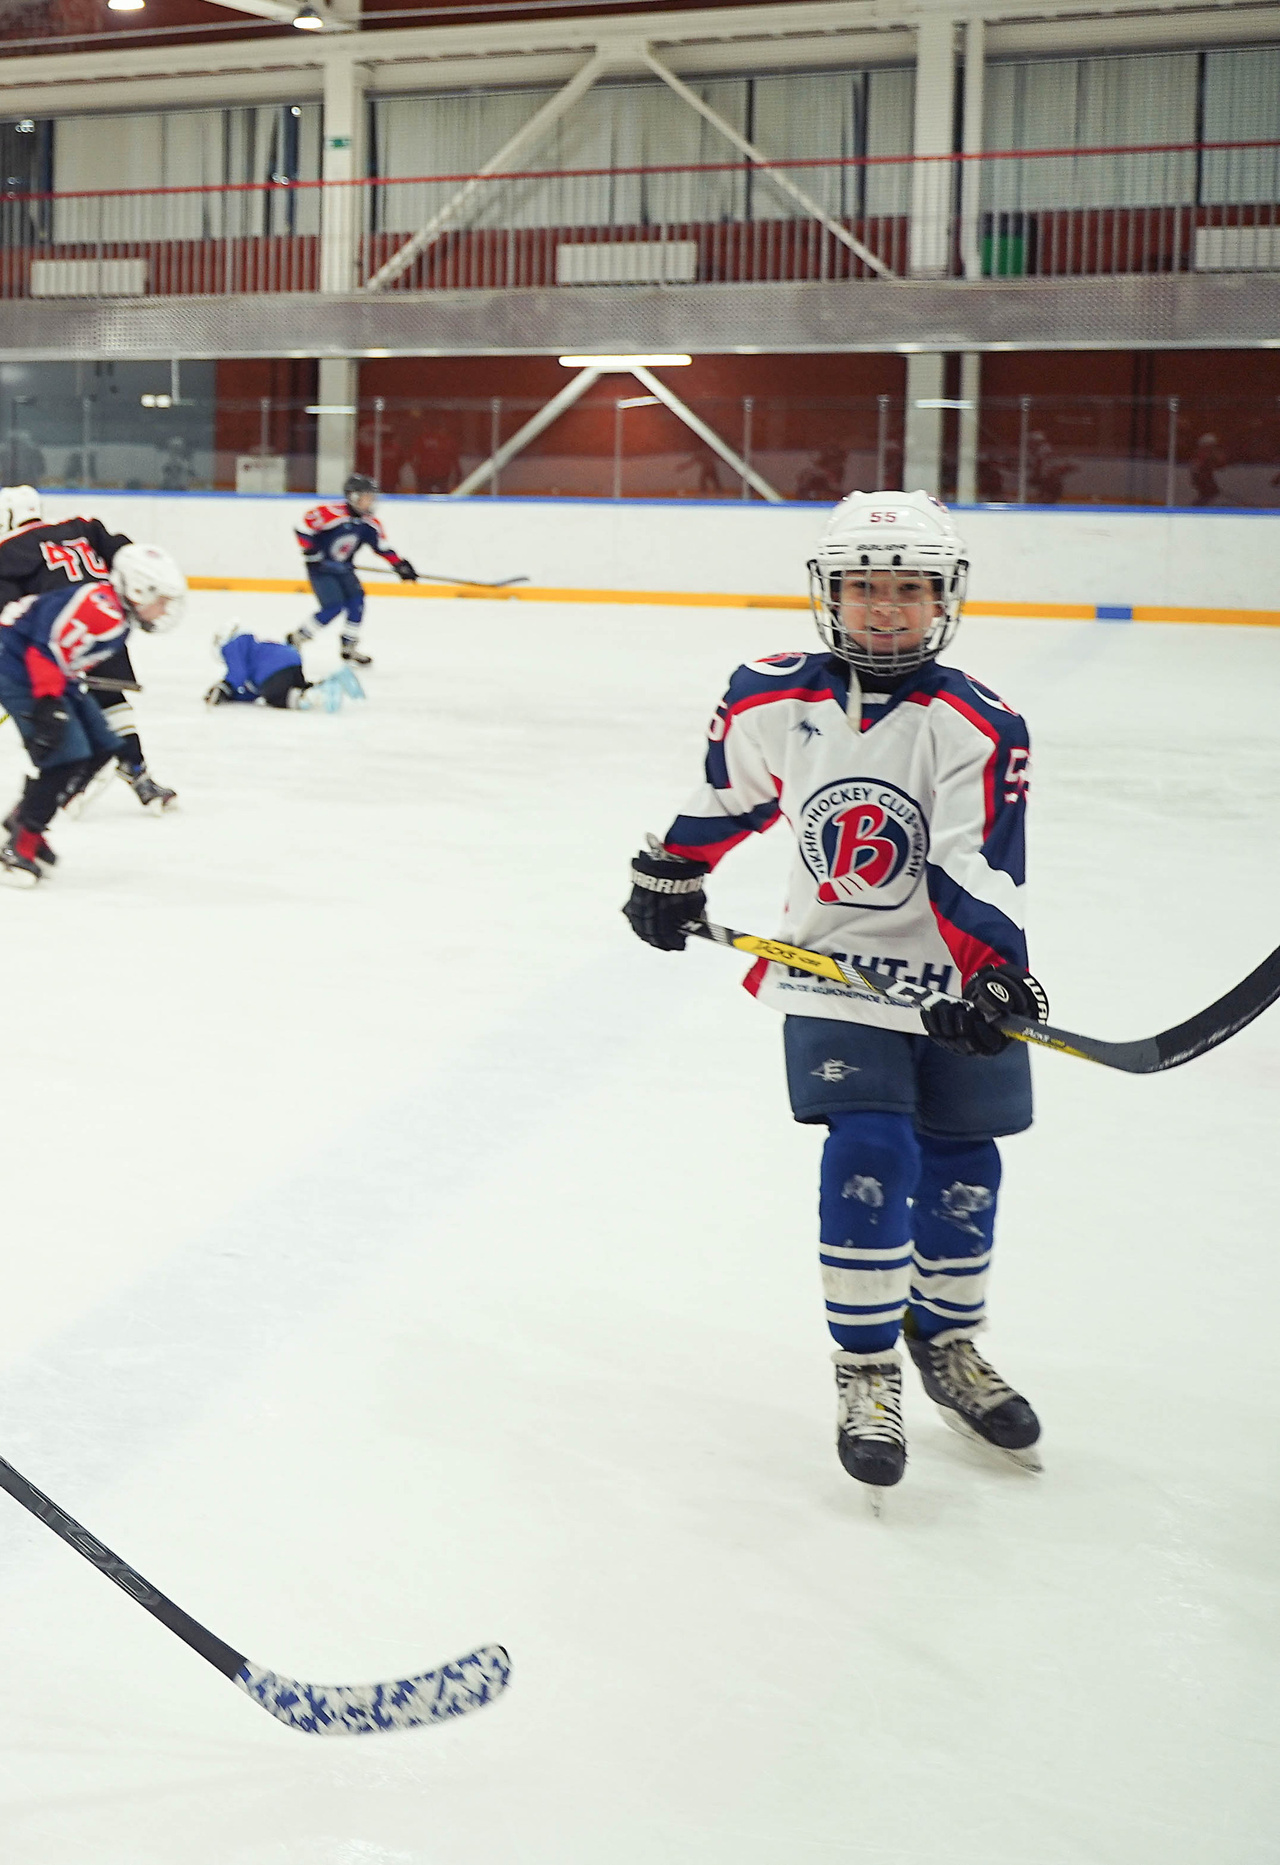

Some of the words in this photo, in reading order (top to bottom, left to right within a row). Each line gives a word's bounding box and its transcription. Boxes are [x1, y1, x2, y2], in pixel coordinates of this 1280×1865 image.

[870, 511, 897, 523] 55
[808, 787, 872, 823] HOCKEY
[878, 793, 918, 825] CLUB
